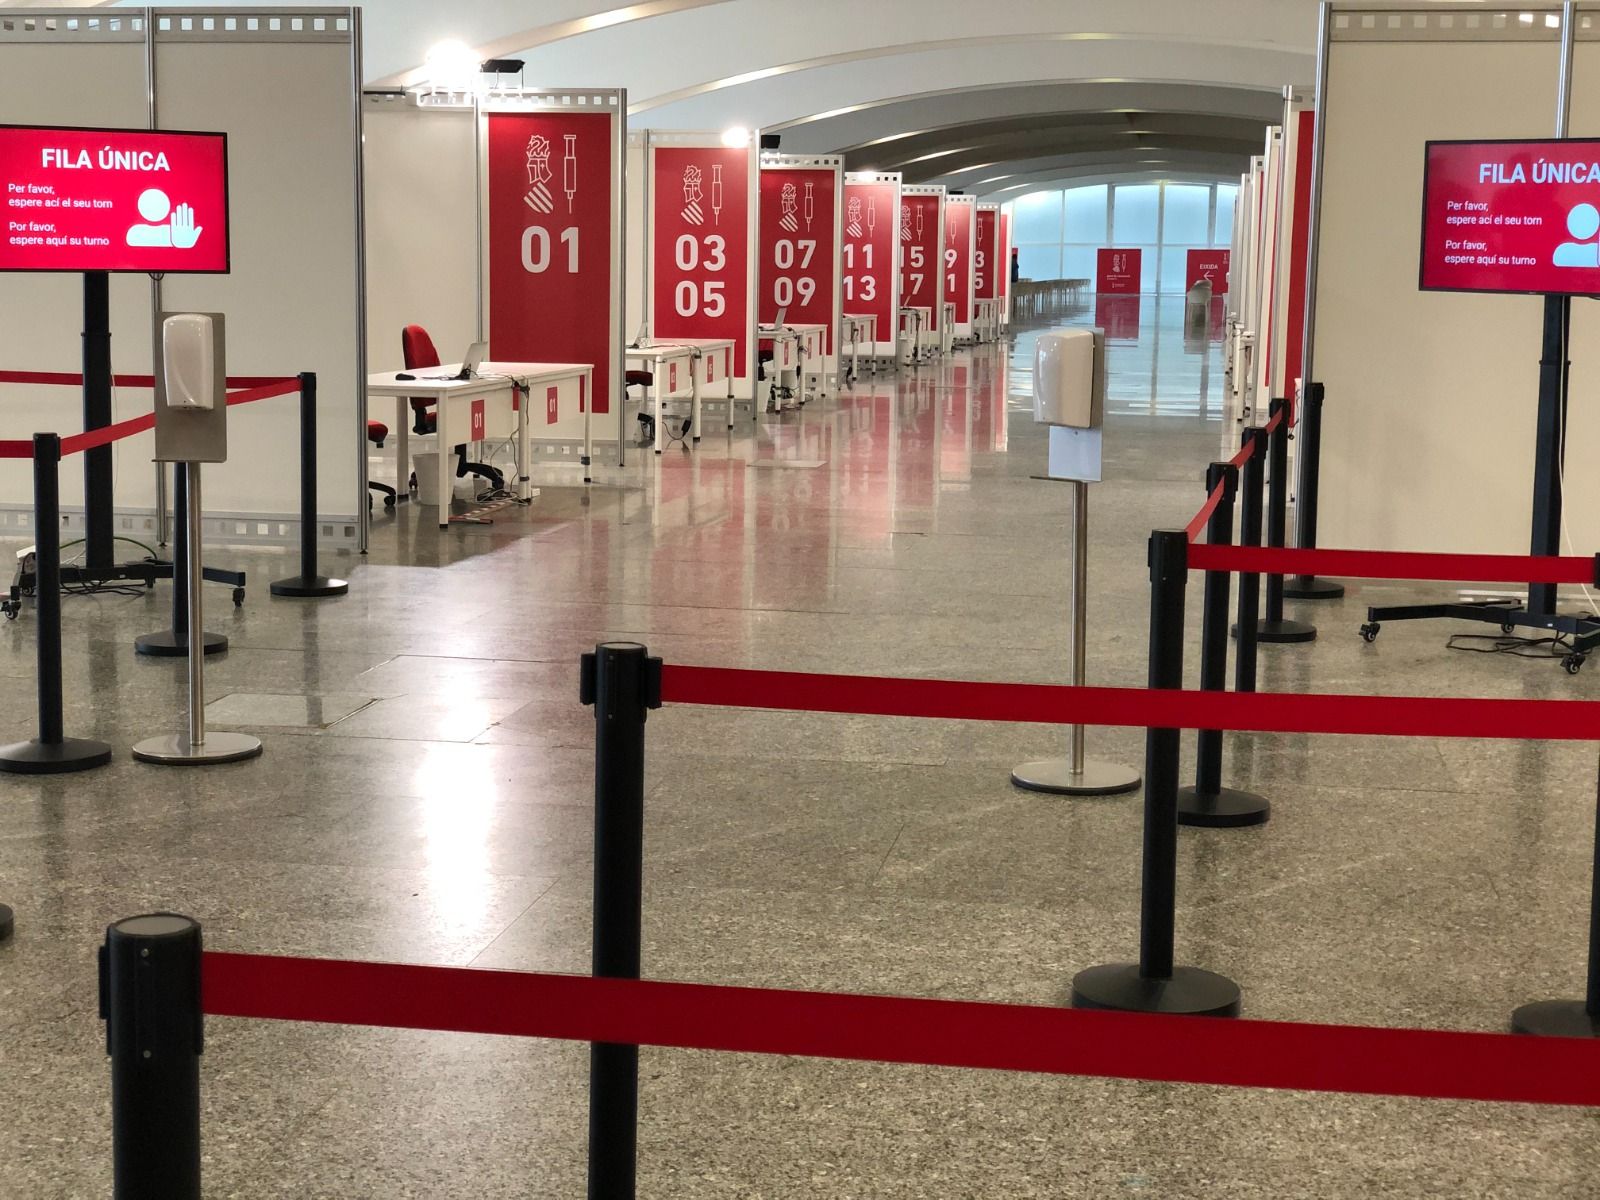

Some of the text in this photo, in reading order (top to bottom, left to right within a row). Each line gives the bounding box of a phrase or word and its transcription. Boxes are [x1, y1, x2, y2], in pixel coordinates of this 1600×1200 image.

[41, 145, 171, 172] FILA ÚNICA
[1479, 158, 1600, 184] FILA ÚNICA
[8, 183, 55, 195] Per favor,
[8, 197, 113, 209] espere ací el seu torn
[1447, 200, 1489, 212] Per favor,
[9, 221, 57, 233] Por favor,
[1446, 214, 1543, 226] espere ací el seu torn
[9, 235, 110, 247] espere aquí su turno
[521, 225, 579, 274] 01
[1445, 239, 1487, 252] Por favor,
[675, 234, 726, 272] 03
[774, 239, 817, 269] 07
[843, 243, 873, 269] 11
[944, 249, 958, 269] 9
[975, 250, 985, 269] 3
[1444, 253, 1537, 266] espere aquí su turno
[843, 275, 876, 301] 13
[947, 273, 956, 293] 1
[975, 272, 984, 290] 5
[675, 280, 726, 318] 05
[774, 276, 816, 307] 09
[474, 412, 482, 429] 01
